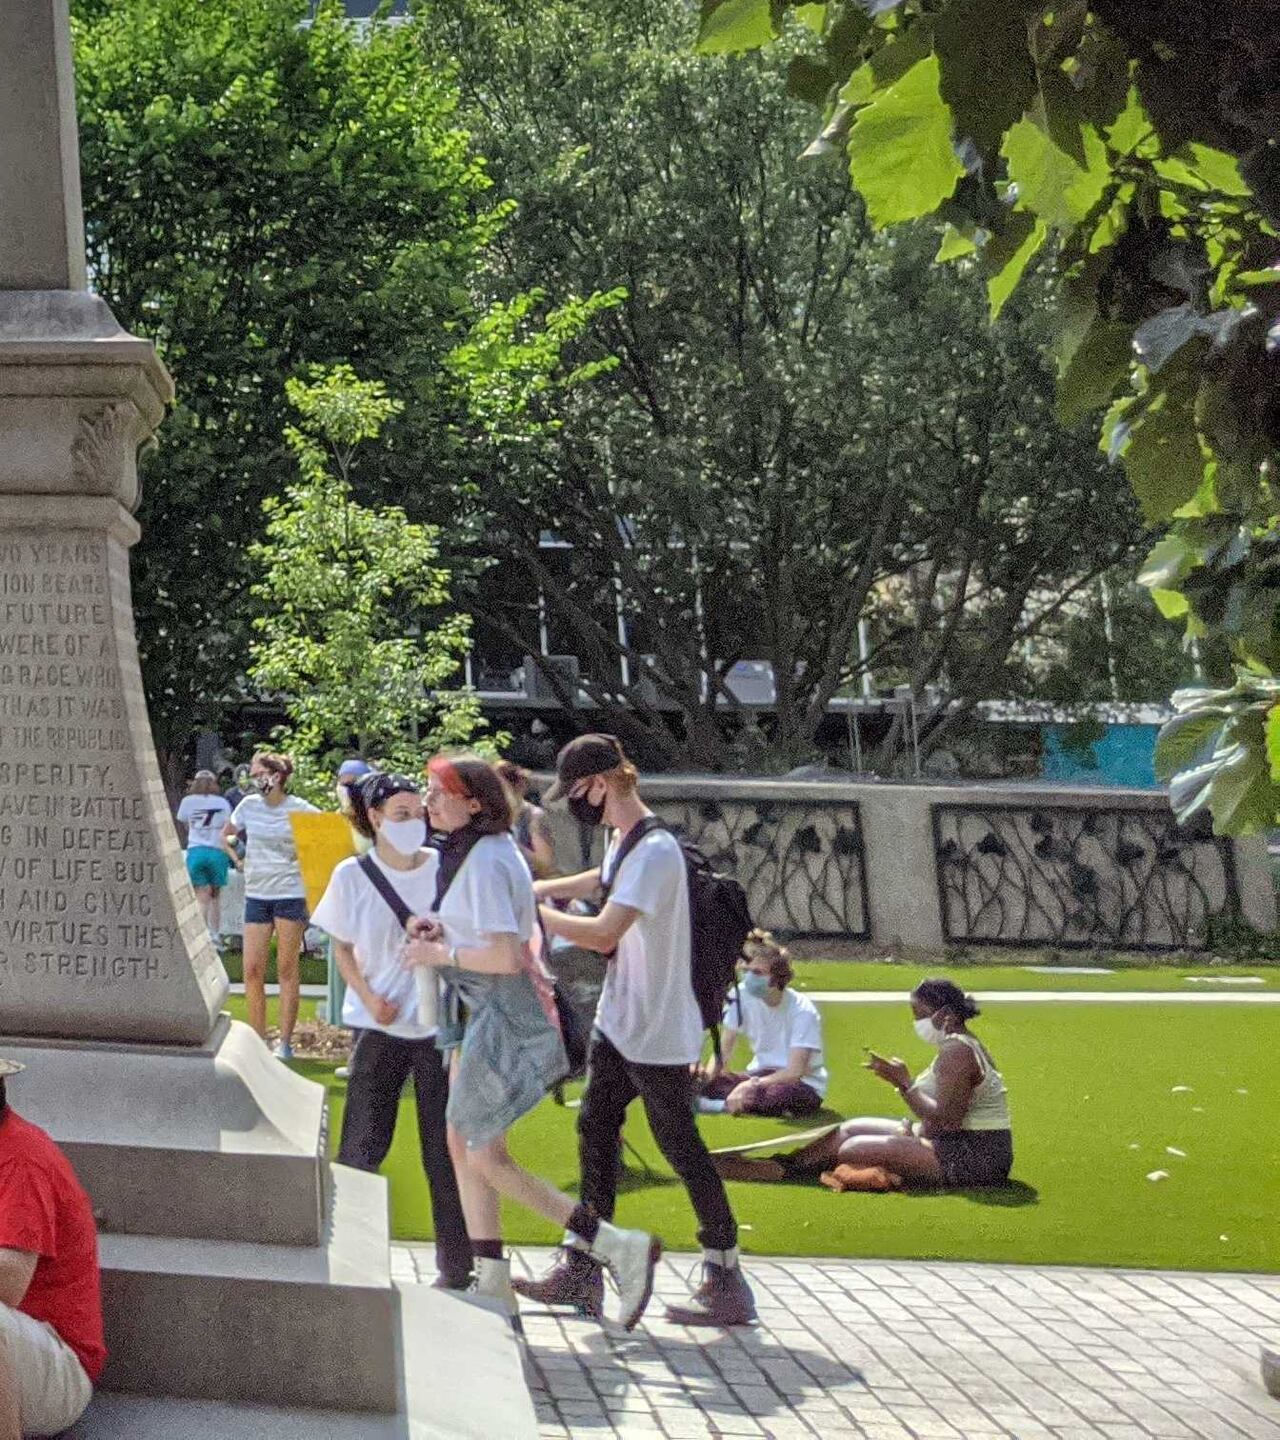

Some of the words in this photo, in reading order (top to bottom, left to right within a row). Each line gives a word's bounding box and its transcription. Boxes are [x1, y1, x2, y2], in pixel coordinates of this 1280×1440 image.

[6, 603, 105, 624] FUTURE
[64, 634, 90, 656] OF
[20, 664, 71, 687] RACE
[57, 696, 75, 718] IT
[24, 826, 47, 847] IN
[14, 857, 41, 879] OF
[52, 859, 102, 882] LIFE
[115, 861, 159, 883] BUT
[18, 890, 67, 911] AND
[84, 891, 151, 916] CIVIC
[5, 920, 109, 946] VIRTUES
[118, 925, 178, 950] THEY
